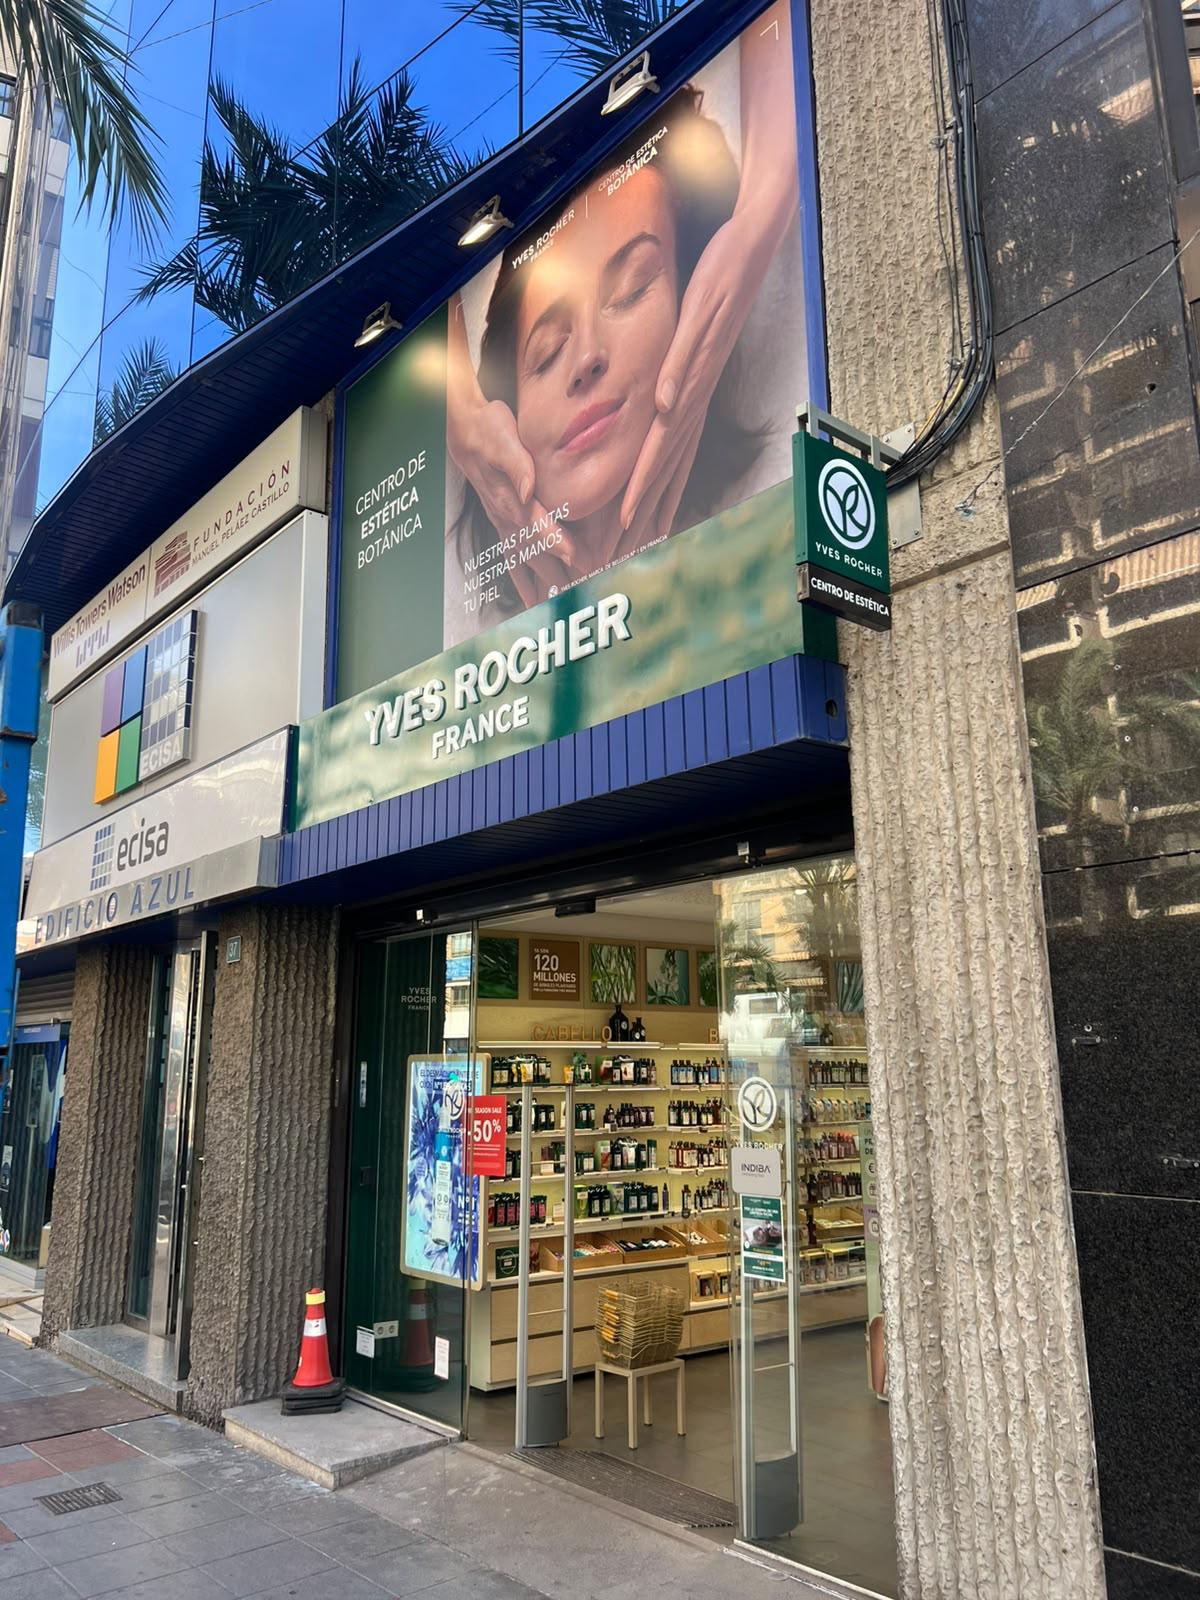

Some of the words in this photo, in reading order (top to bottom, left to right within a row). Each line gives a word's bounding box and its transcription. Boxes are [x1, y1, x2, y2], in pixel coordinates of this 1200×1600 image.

[598, 164, 625, 192] CENTRO
[625, 155, 635, 168] DE
[635, 126, 668, 158] ESTÉTICA
[607, 146, 658, 196] BOTÁNICA
[512, 244, 534, 269] YVES
[536, 208, 575, 249] ROCHER
[193, 460, 290, 552] FUNDACIÓN
[355, 467, 406, 515] CENTRO
[408, 450, 427, 479] DE
[192, 538, 219, 565] MANUEL
[221, 512, 249, 541] PELÁEZ
[251, 481, 290, 518] CASTILLO
[361, 486, 419, 539] ESTÉTICA
[464, 533, 516, 575] NUESTRAS
[519, 502, 570, 543] PLANTAS
[358, 513, 422, 569] BOTÁNICA
[464, 554, 516, 595] NUESTRAS
[519, 528, 562, 563] MANOS
[815, 541, 840, 560] YVES
[844, 554, 882, 578] ROCHER
[53, 624, 76, 658] Willis
[75, 599, 107, 638] Towers
[107, 564, 146, 610] Watson
[464, 599, 478, 614] TU
[479, 585, 501, 608] PIEL
[811, 577, 843, 598] CENTRO
[844, 590, 855, 603] DE
[855, 594, 889, 616] ESTÉTICA
[364, 678, 446, 745] YVES
[454, 592, 632, 710] ROCHER
[432, 695, 530, 760] FRANCE
[140, 741, 182, 775] ECISA
[117, 819, 168, 872] ecisa
[34, 892, 118, 944] EDIFICIO
[130, 867, 194, 916] AZUL
[229, 941, 238, 959] 37
[534, 954, 559, 971] 120
[401, 995, 437, 1003] ROCHER
[409, 987, 431, 995] YVES
[533, 971, 577, 983] MILLONES
[532, 1024, 613, 1042] CABELLO
[474, 1106, 491, 1114] SEASON
[491, 1106, 503, 1114] SALE
[741, 1163, 771, 1174] INDIBA
